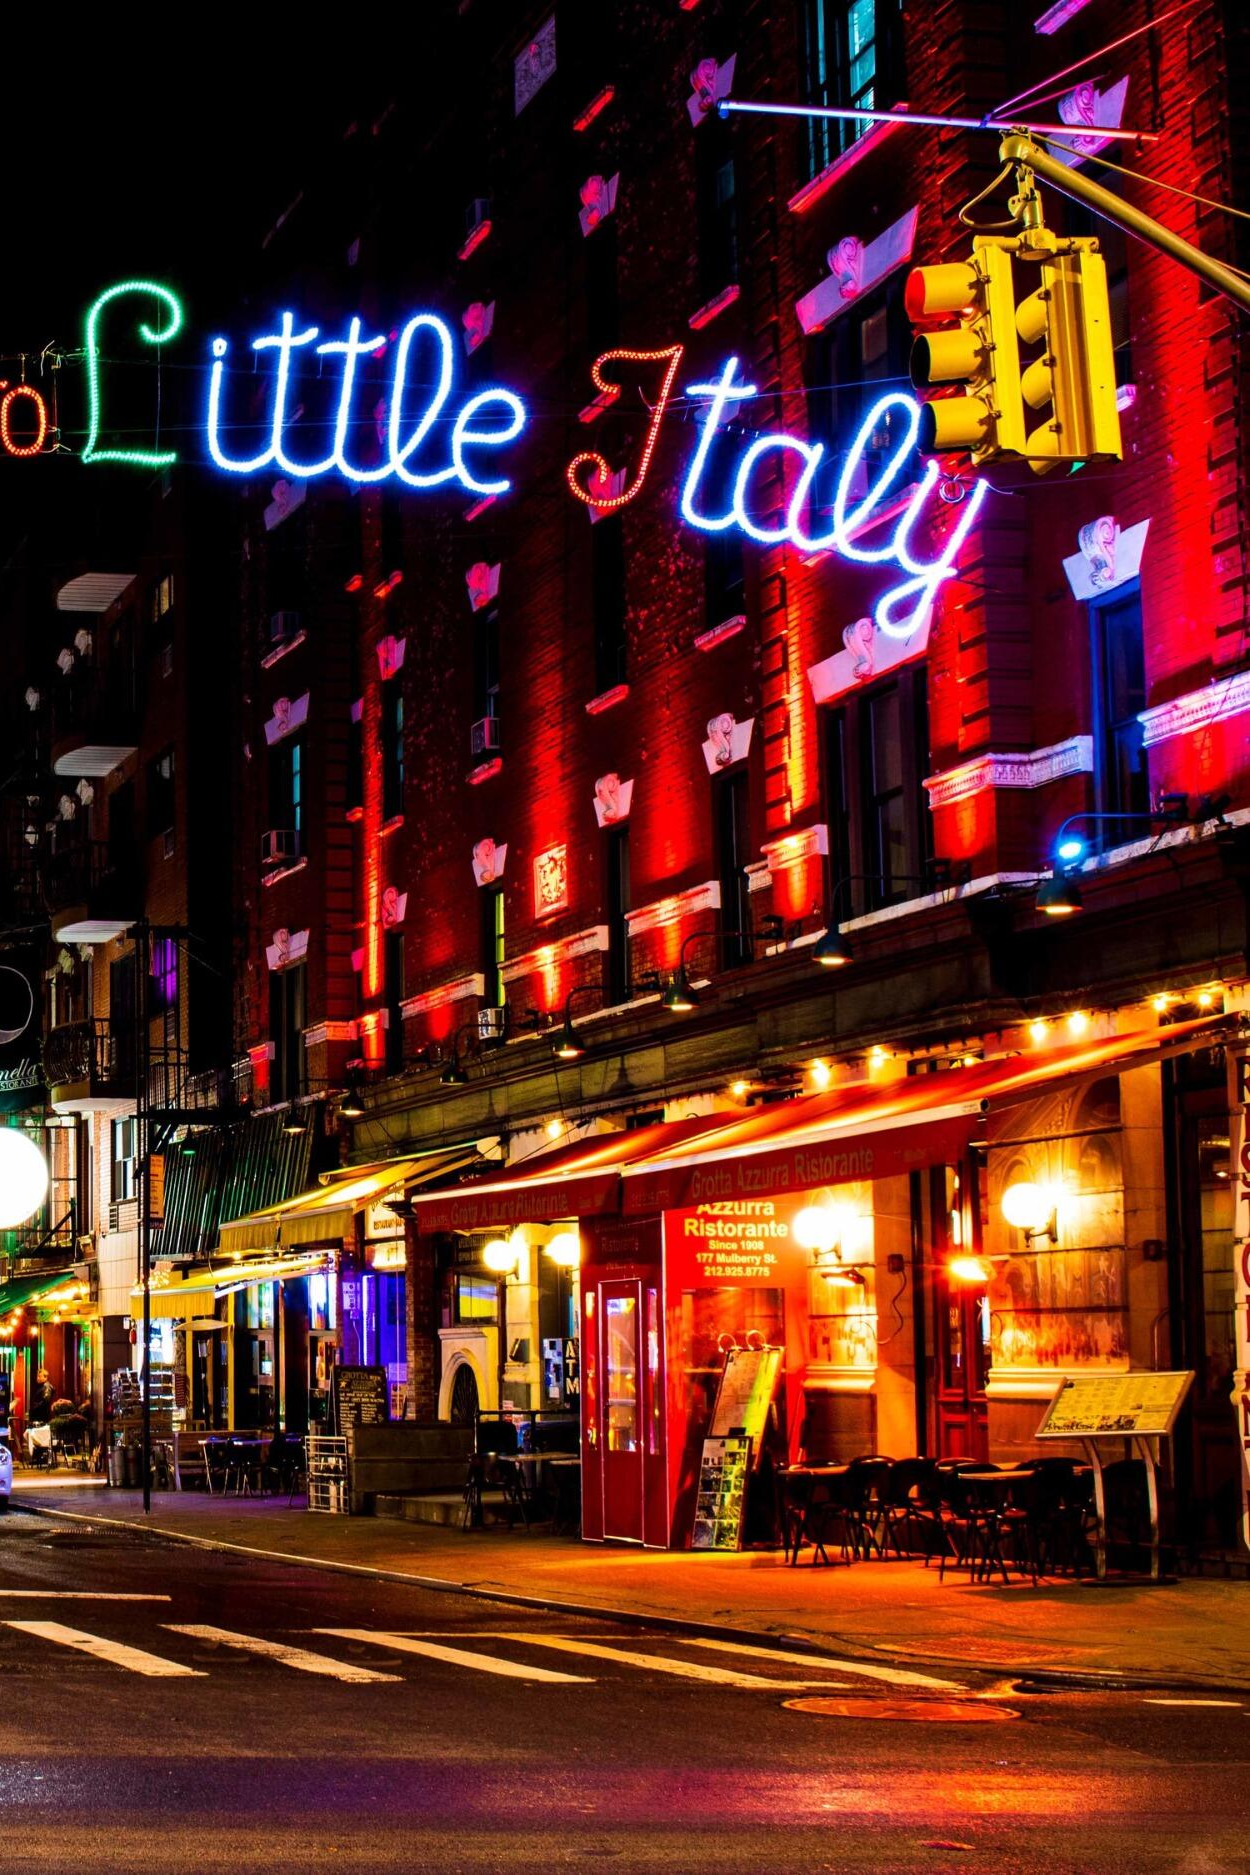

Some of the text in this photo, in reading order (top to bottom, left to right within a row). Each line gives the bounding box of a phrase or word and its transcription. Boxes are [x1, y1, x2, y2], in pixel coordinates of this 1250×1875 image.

[80, 281, 526, 494] Little
[566, 343, 990, 639] Italy
[690, 1169, 733, 1199] Grotta
[736, 1163, 790, 1191] Azzurra
[794, 1147, 874, 1183] Ristorante
[697, 1201, 775, 1216] Azzurra
[684, 1218, 788, 1237] Ristorante
[708, 1240, 738, 1250] Since
[696, 1252, 778, 1265] 177 Mulberry St.
[704, 1265, 770, 1277] 212.925.8775
[565, 1340, 579, 1395] ATM
